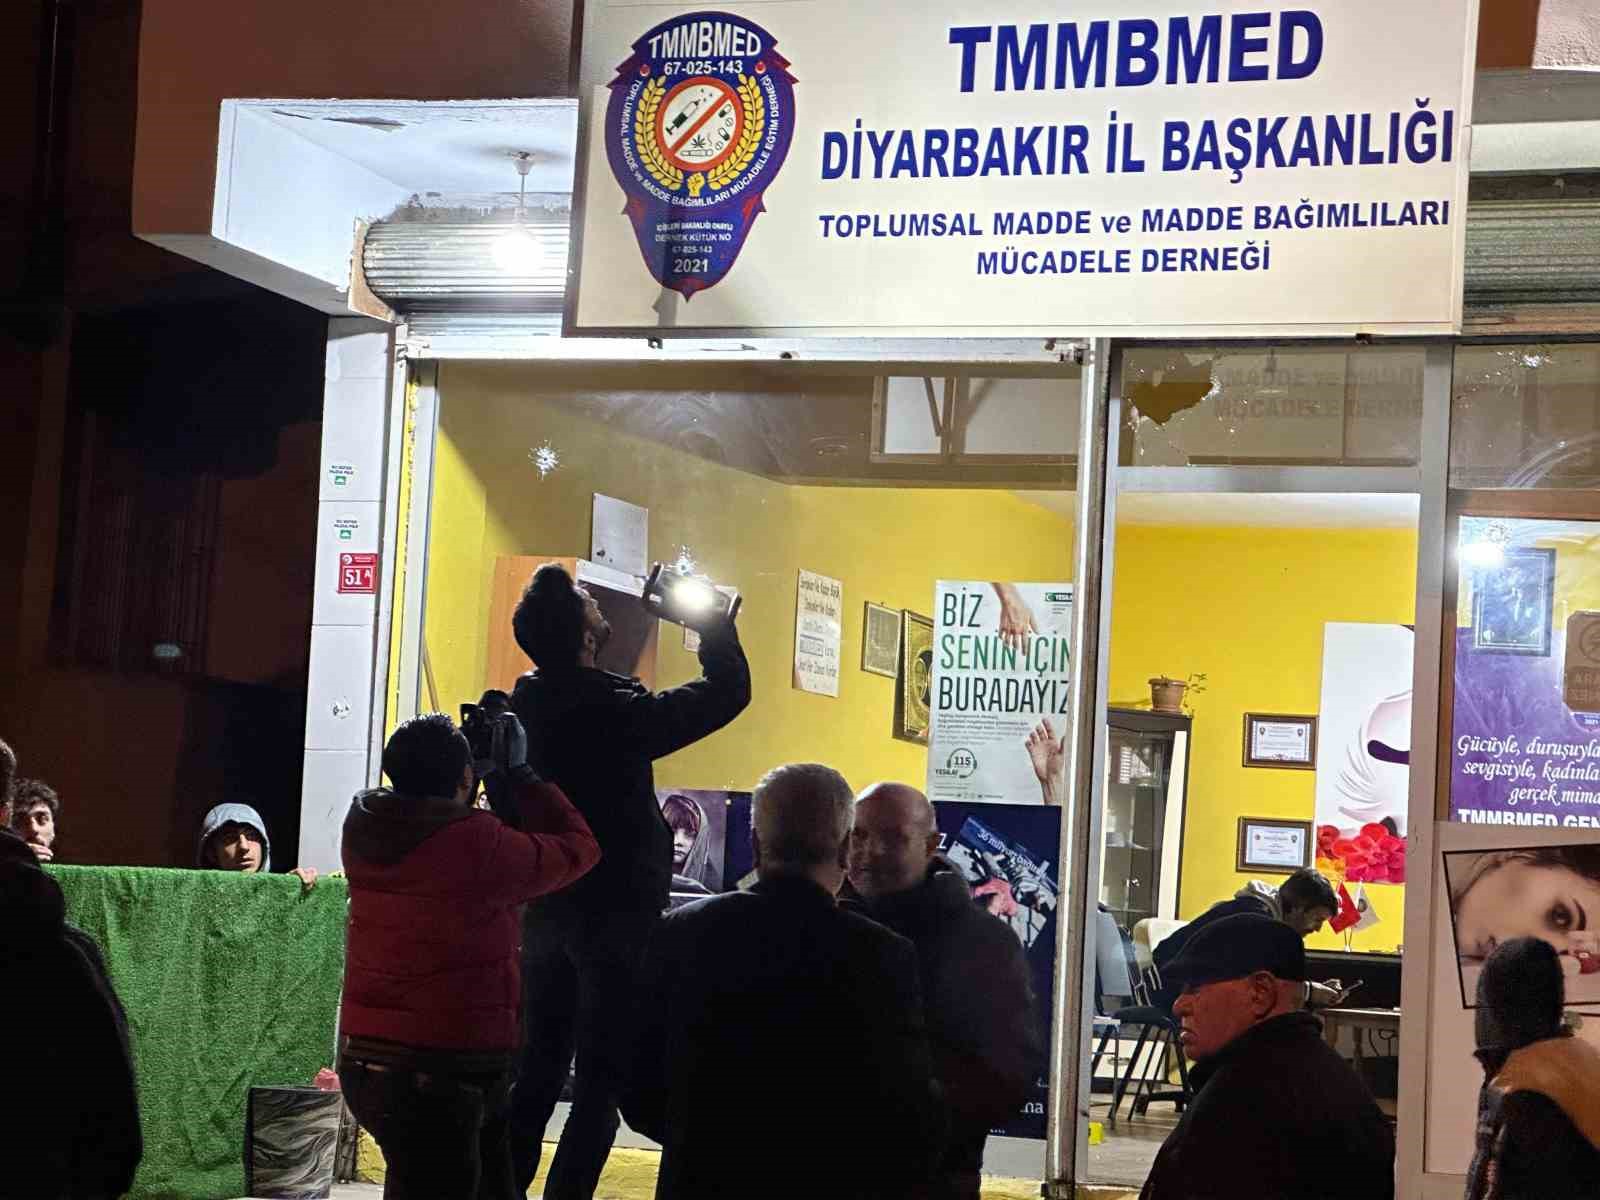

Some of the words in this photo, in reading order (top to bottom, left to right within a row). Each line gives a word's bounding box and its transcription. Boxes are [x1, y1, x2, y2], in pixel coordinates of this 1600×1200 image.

[648, 21, 762, 59] TMMBMED
[949, 11, 1324, 93] TMMBMED
[664, 60, 743, 75] 67-025-143
[621, 80, 643, 136] TOPLUMSAL
[622, 138, 639, 171] MADDE
[821, 119, 1089, 179] DİYARBAKIR
[1107, 111, 1145, 173] İL
[1162, 98, 1454, 184] BAŞKANLIĞI
[642, 179, 671, 202] MADDE
[819, 213, 983, 238] TOPLUMSAL
[994, 211, 1091, 235] MADDE
[1101, 216, 1131, 234] ve
[1143, 207, 1243, 232] MADDE
[1254, 199, 1449, 229] BAĞIMLILARI
[719, 233, 732, 241] NO
[674, 258, 708, 273] 2021
[977, 244, 1131, 275] MÜCADELE
[1142, 240, 1270, 273] DERNEĞİ
[942, 586, 984, 628] BİZ
[940, 629, 1017, 672] SENİN
[1025, 630, 1071, 678] İÇİN
[938, 676, 1069, 715] BURADAYIZ
[954, 755, 971, 767] 115
[1457, 734, 1521, 758] Gücüyle,
[1526, 736, 1600, 762] duruşuyla
[1463, 759, 1537, 782] sevgisiyle,
[1542, 760, 1600, 782] kadınla
[1508, 783, 1560, 807] gerçek
